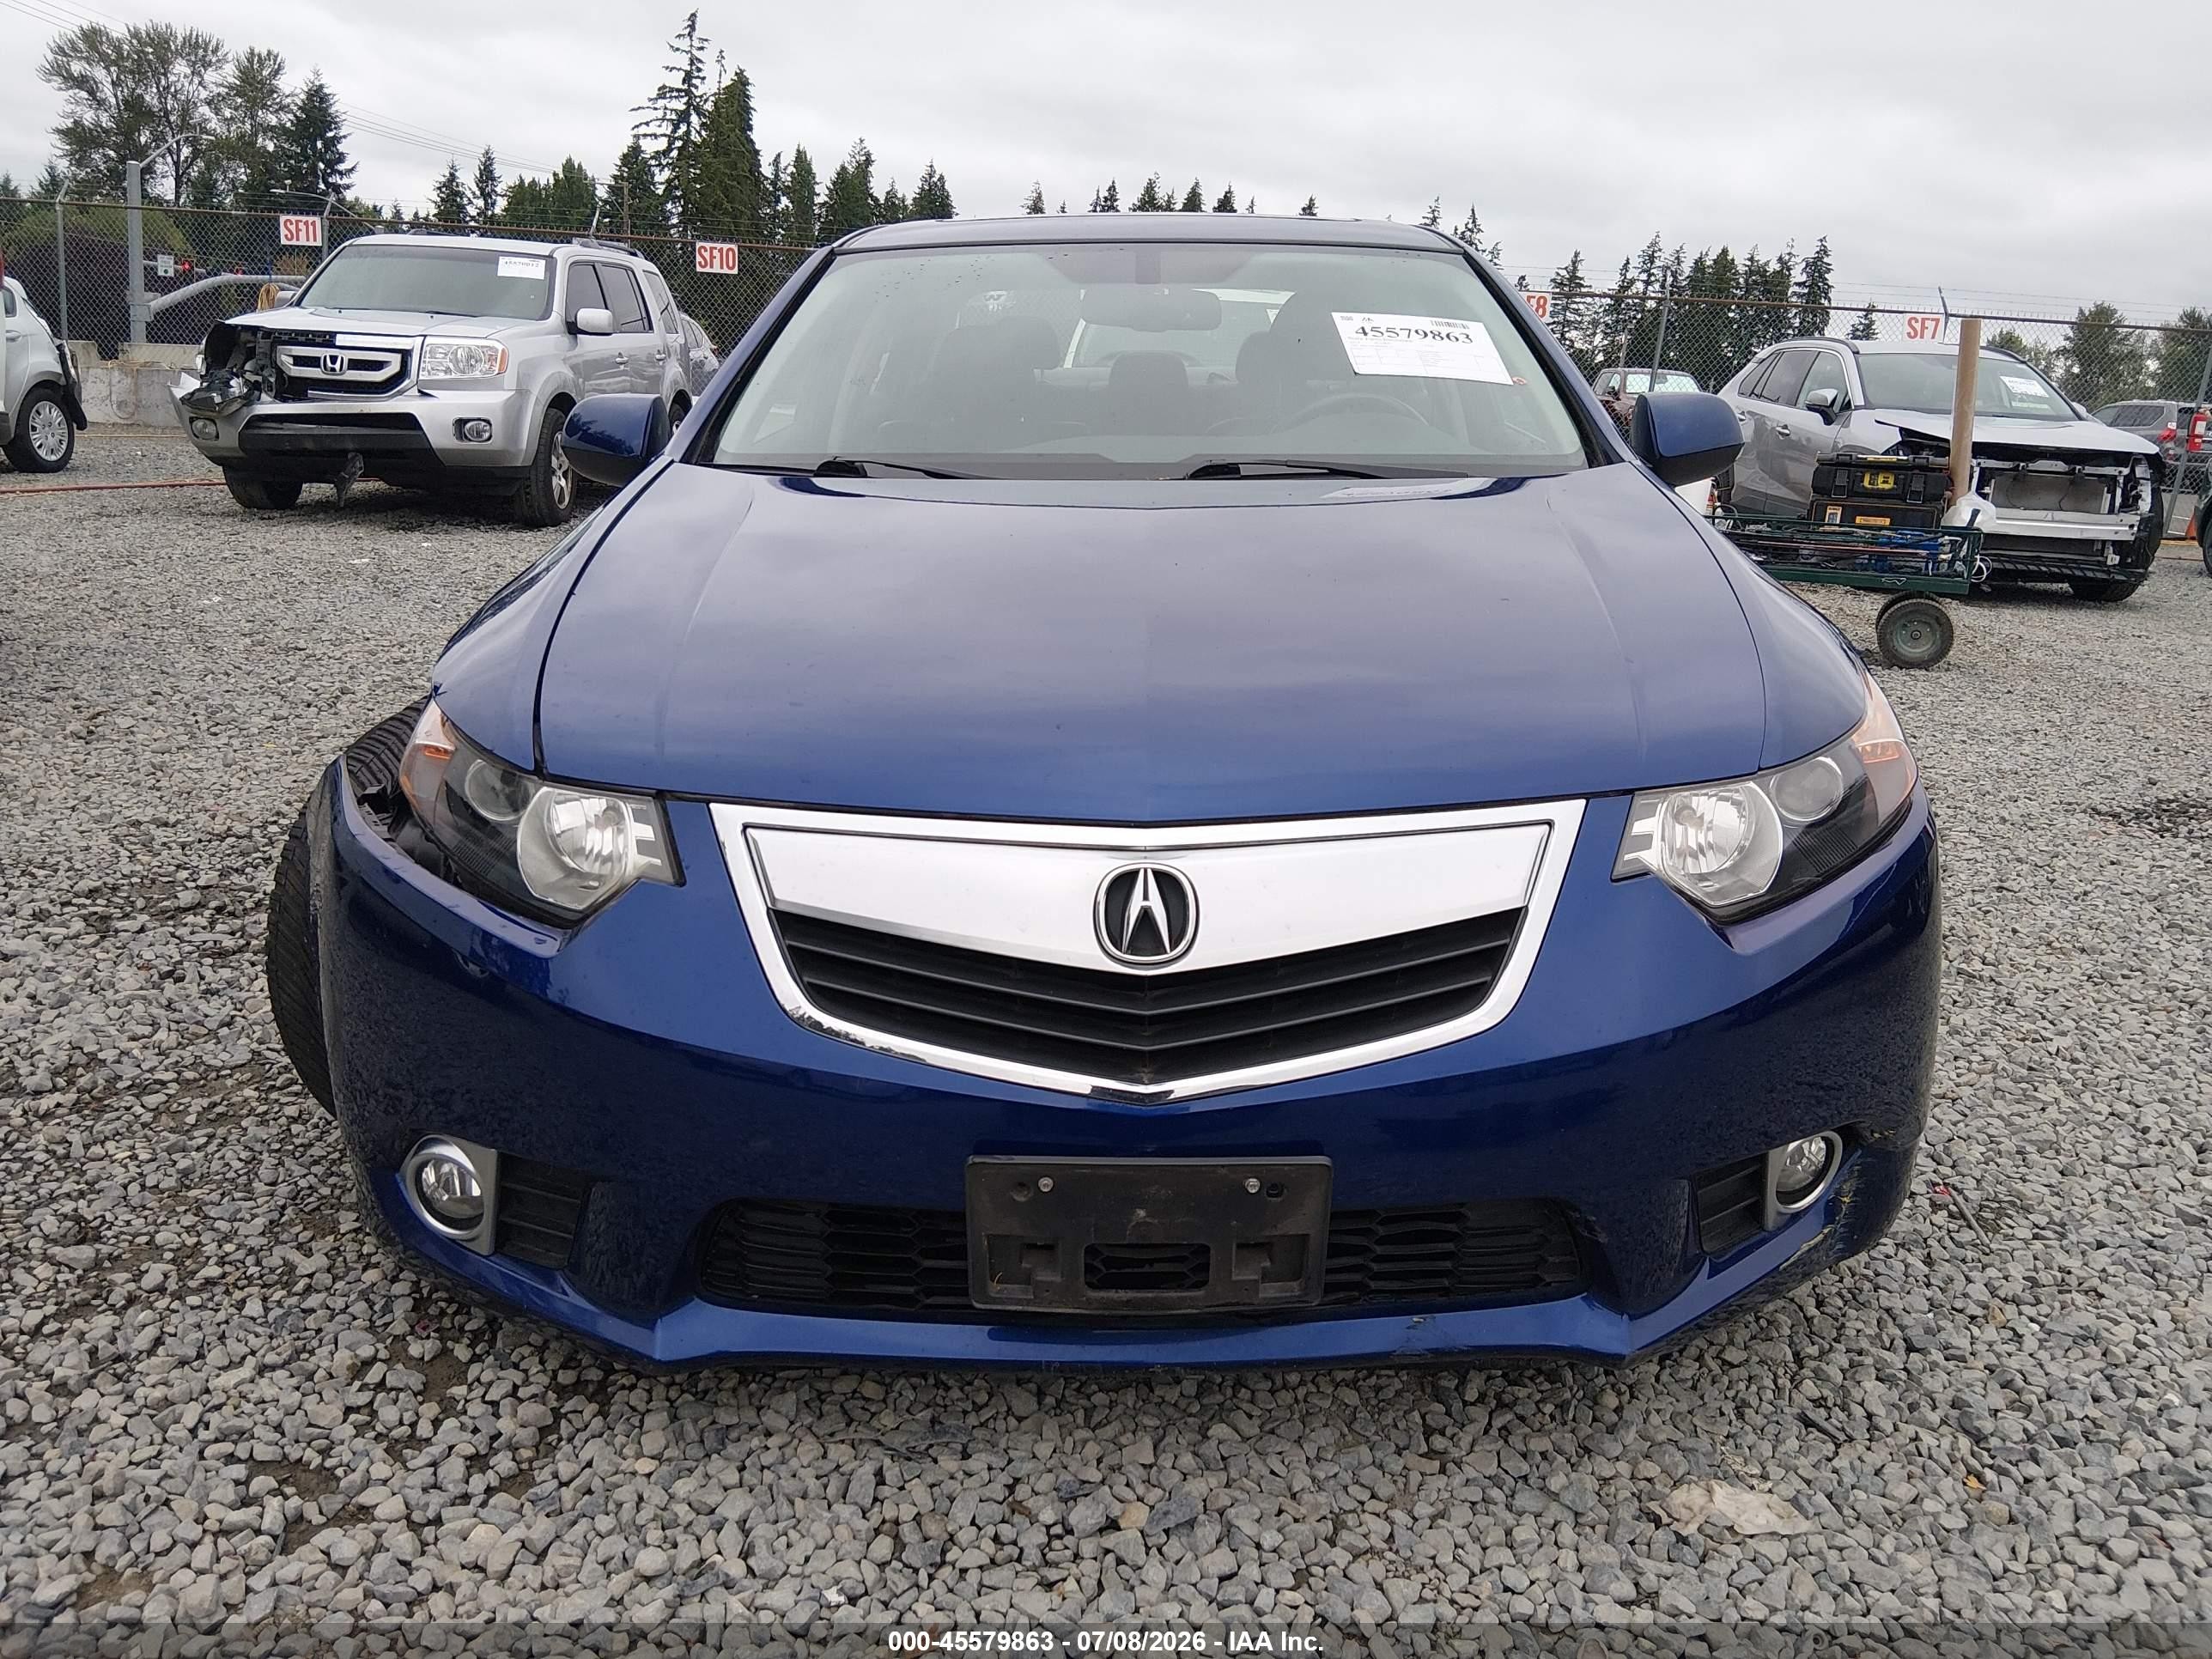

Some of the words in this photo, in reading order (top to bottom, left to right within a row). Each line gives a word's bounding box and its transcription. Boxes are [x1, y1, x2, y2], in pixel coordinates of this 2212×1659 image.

[283, 219, 317, 242] SF11
[697, 246, 737, 270] SF10
[1526, 295, 1547, 318] F8
[1355, 325, 1474, 344] 45579863
[1906, 316, 1940, 339] SF7
